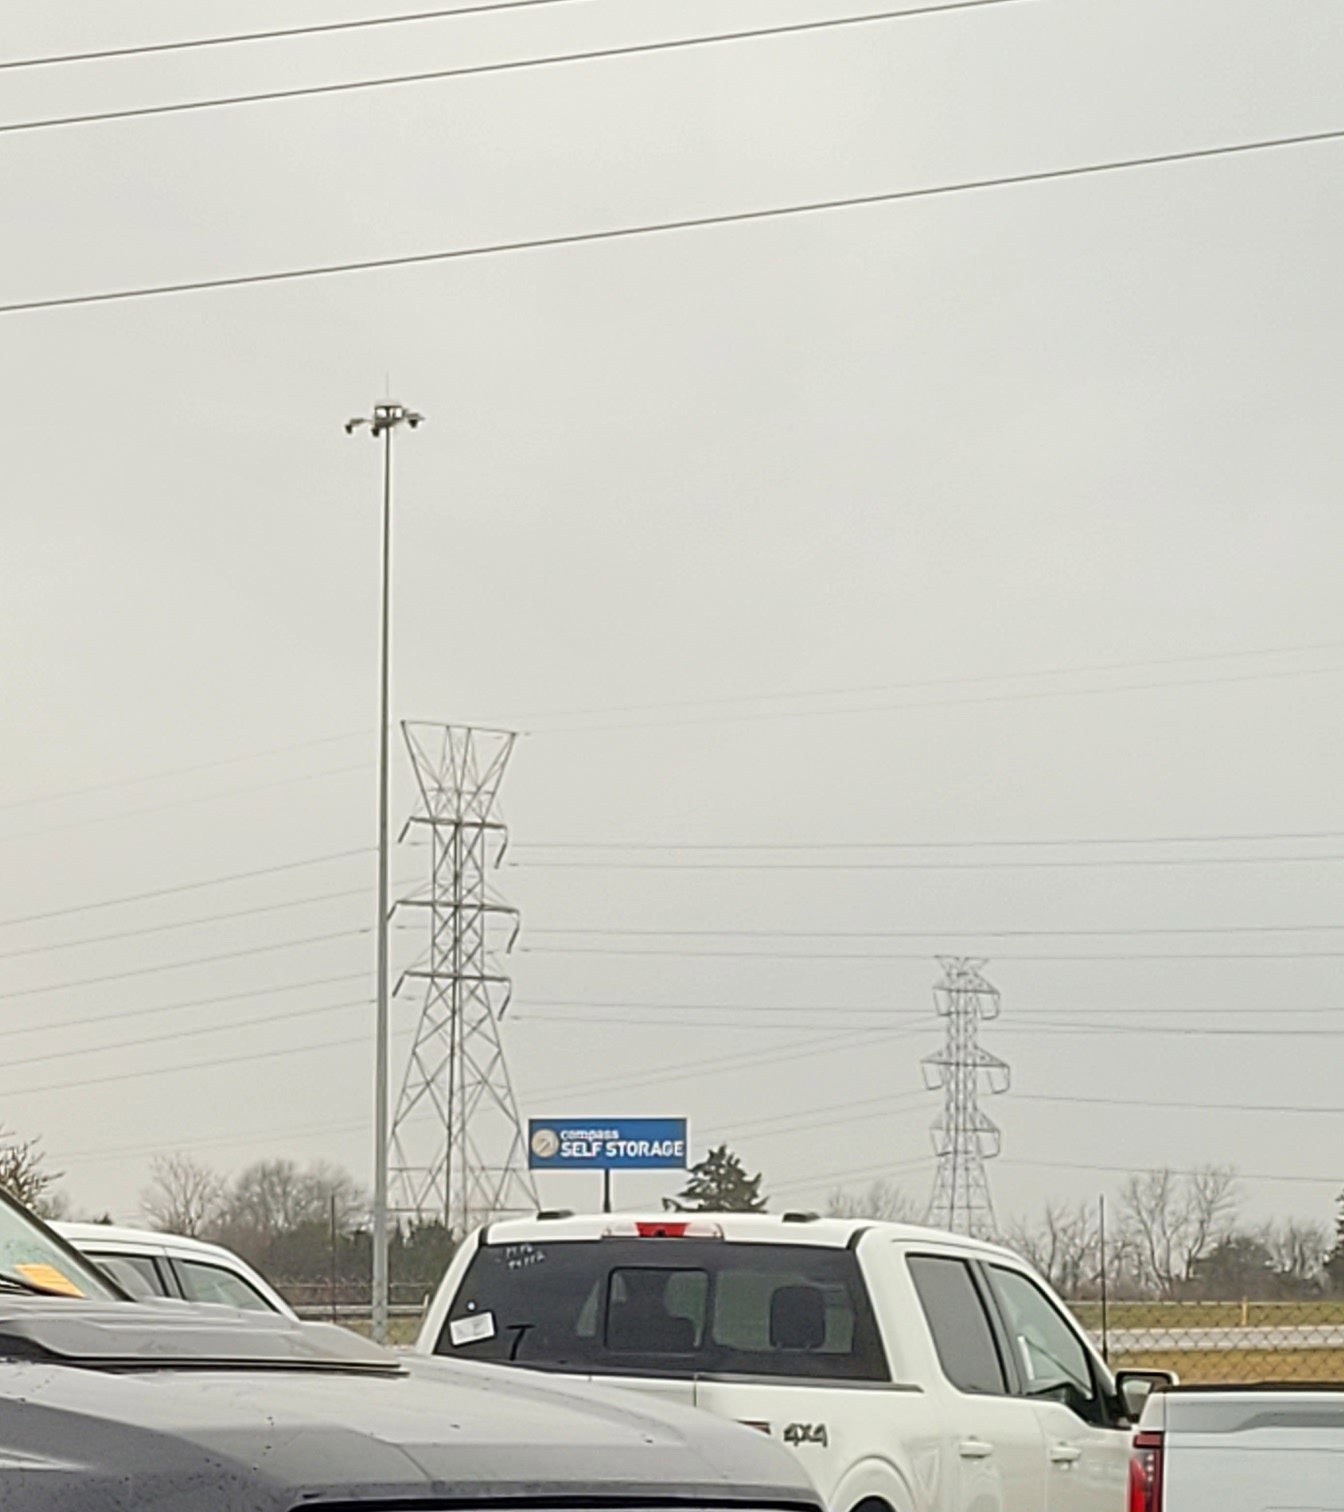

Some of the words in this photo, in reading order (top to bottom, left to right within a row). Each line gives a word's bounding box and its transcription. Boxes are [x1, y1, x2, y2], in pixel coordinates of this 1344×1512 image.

[560, 1129, 619, 1142] compass
[560, 1141, 602, 1158] SELF
[605, 1140, 684, 1157] STORAGE
